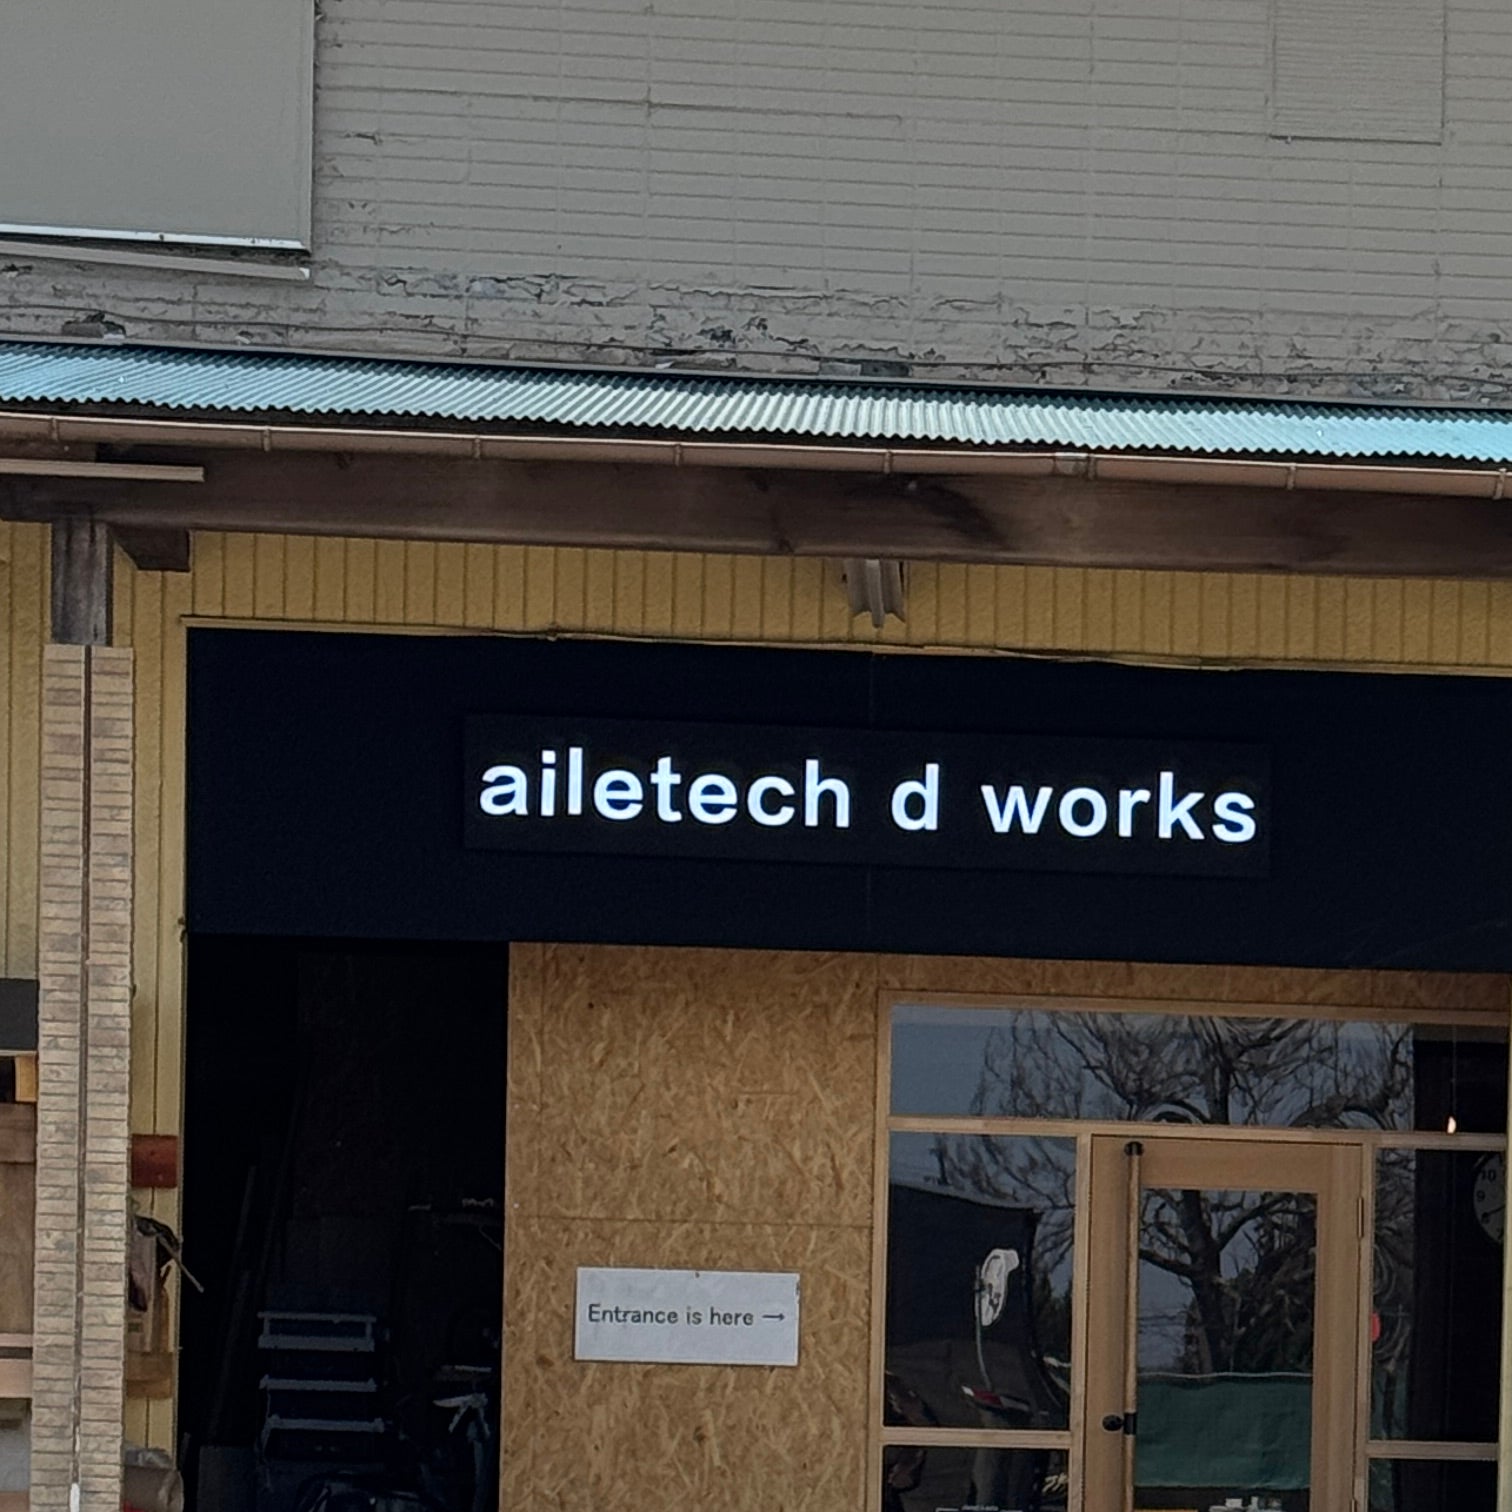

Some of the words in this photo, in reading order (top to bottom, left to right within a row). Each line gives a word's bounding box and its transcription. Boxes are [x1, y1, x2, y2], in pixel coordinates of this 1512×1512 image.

[479, 747, 850, 828] ailetech
[891, 763, 940, 831] d
[981, 771, 1257, 843] works
[588, 1303, 679, 1324] Entrance
[686, 1306, 702, 1325] is
[709, 1306, 754, 1326] here
